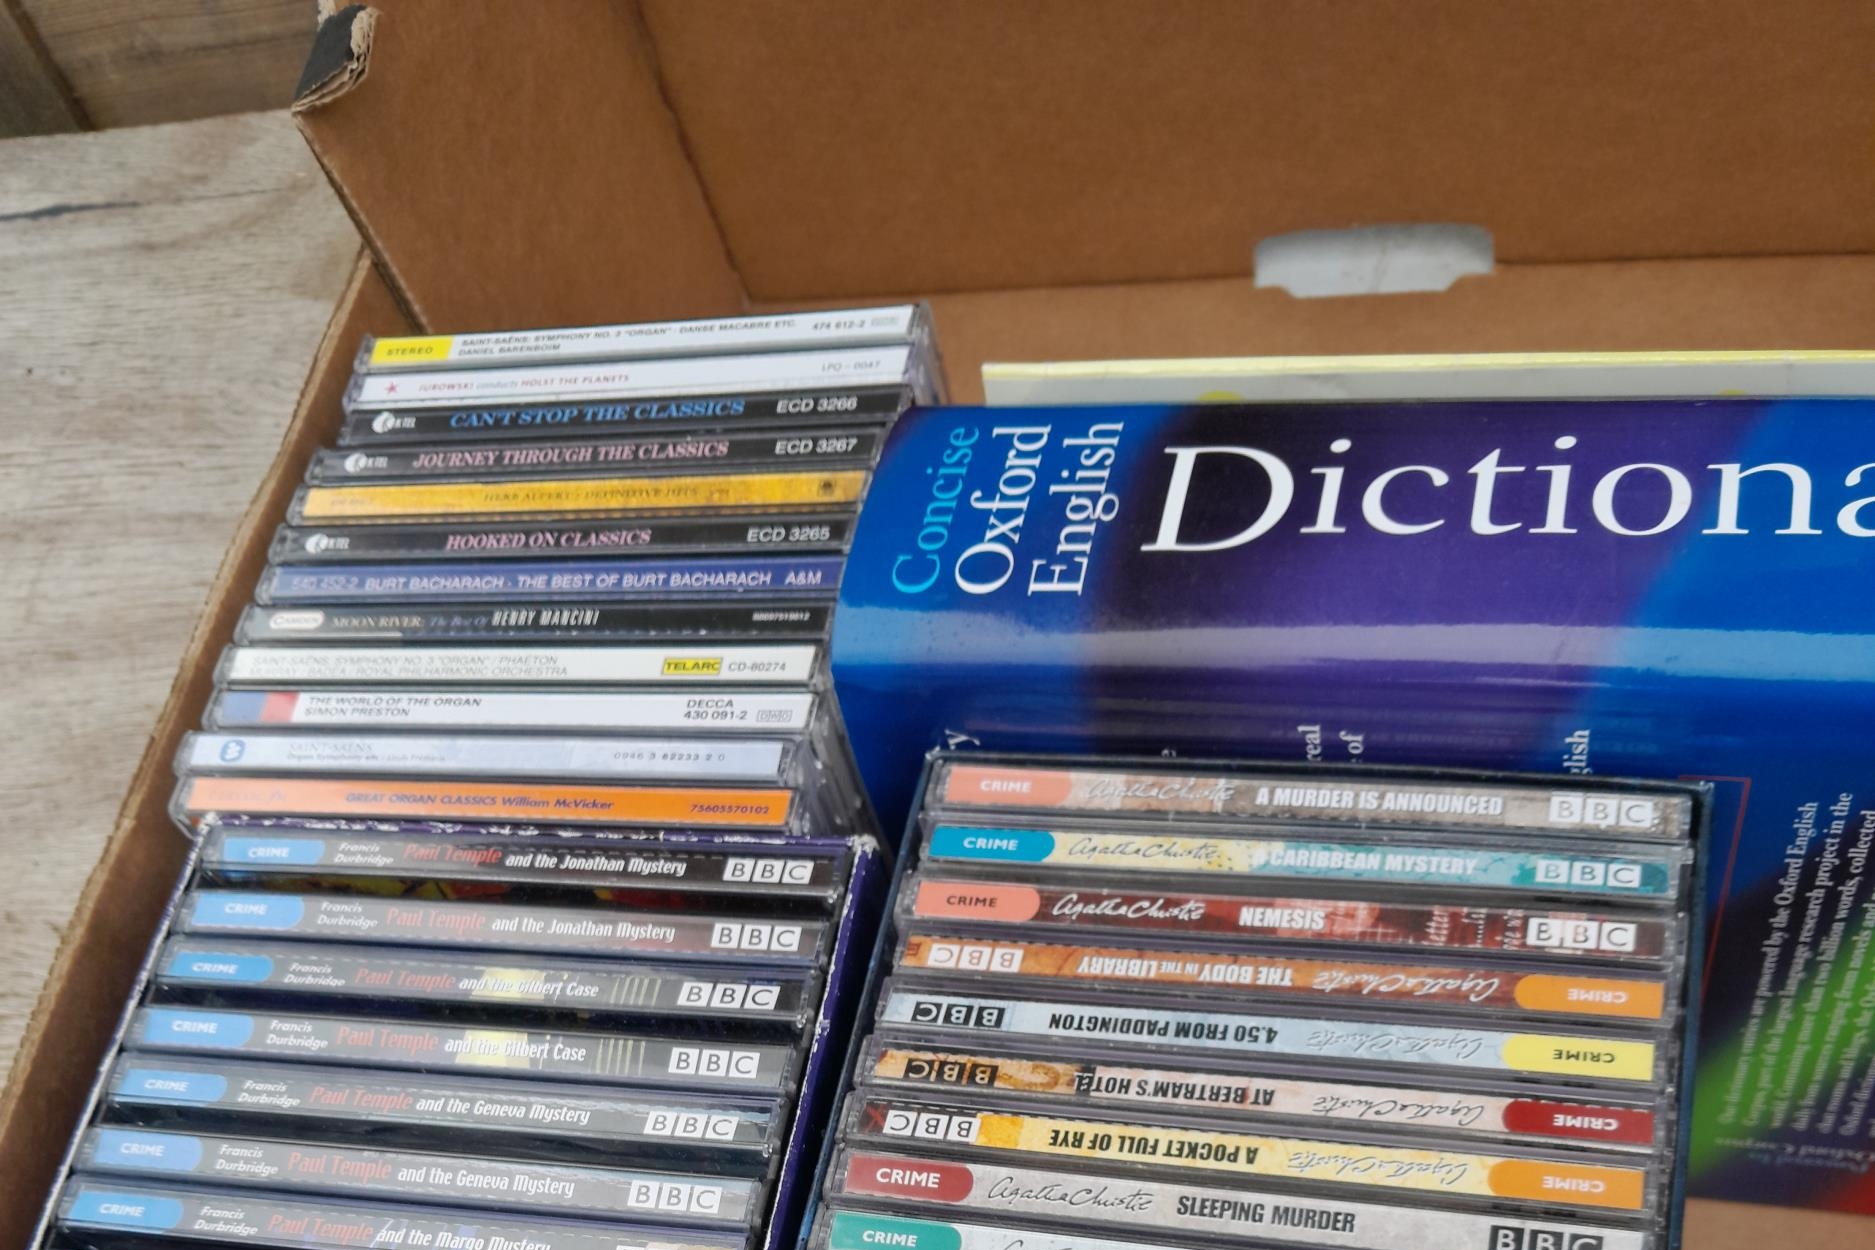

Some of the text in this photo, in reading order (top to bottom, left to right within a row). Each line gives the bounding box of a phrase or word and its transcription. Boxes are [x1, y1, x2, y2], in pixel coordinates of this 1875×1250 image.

[386, 346, 434, 357] STEREO
[450, 400, 745, 428] CAN'T STOP THE CLASSICS
[777, 397, 858, 414] ECD 3266
[412, 440, 730, 469] JOURNEY THROUGH THE CLASSICS
[775, 438, 857, 455] ECD 3267
[892, 425, 979, 594] Concise
[954, 424, 1052, 594] Oxford
[1027, 421, 1124, 596] English
[365, 570, 822, 592] BURT BACHARACH THE BEST OF BURT BACHARACH A&M
[491, 608, 600, 627] HENRY MANCINI
[665, 661, 786, 672] TELARC CD-80274
[305, 707, 410, 717] SIMON PRESTON
[308, 697, 482, 707] THE WORLD OF THE ORGAN
[687, 699, 734, 709] DECCA
[683, 710, 747, 721] 430 091-2
[502, 797, 613, 810] William McVicker
[690, 804, 769, 815] 75605570102
[980, 779, 1651, 825] CRIME A MURDER IS ANNOUNCED BBC
[1830, 792, 1853, 817] the
[1786, 802, 1819, 855] English
[1823, 819, 1846, 834] in
[248, 847, 290, 858] CRIME
[339, 842, 380, 854] Francis
[334, 853, 394, 867] Durbridge
[505, 853, 811, 883] and the Jonathan Mystery BBC
[963, 836, 1638, 886] CRIME MYSTERY BBC
[946, 895, 1632, 949] CRIME NEMESIS BBC
[1077, 955, 1628, 1004] CRIME THE BODY IN THE LIBRARY
[287, 1152, 721, 1212] Paul Temple and the Geneva Mystery BBC
[875, 1167, 941, 1189] CRIME
[1176, 1195, 1265, 1224] SLEEPING
[1271, 1206, 1355, 1233] MURDER
